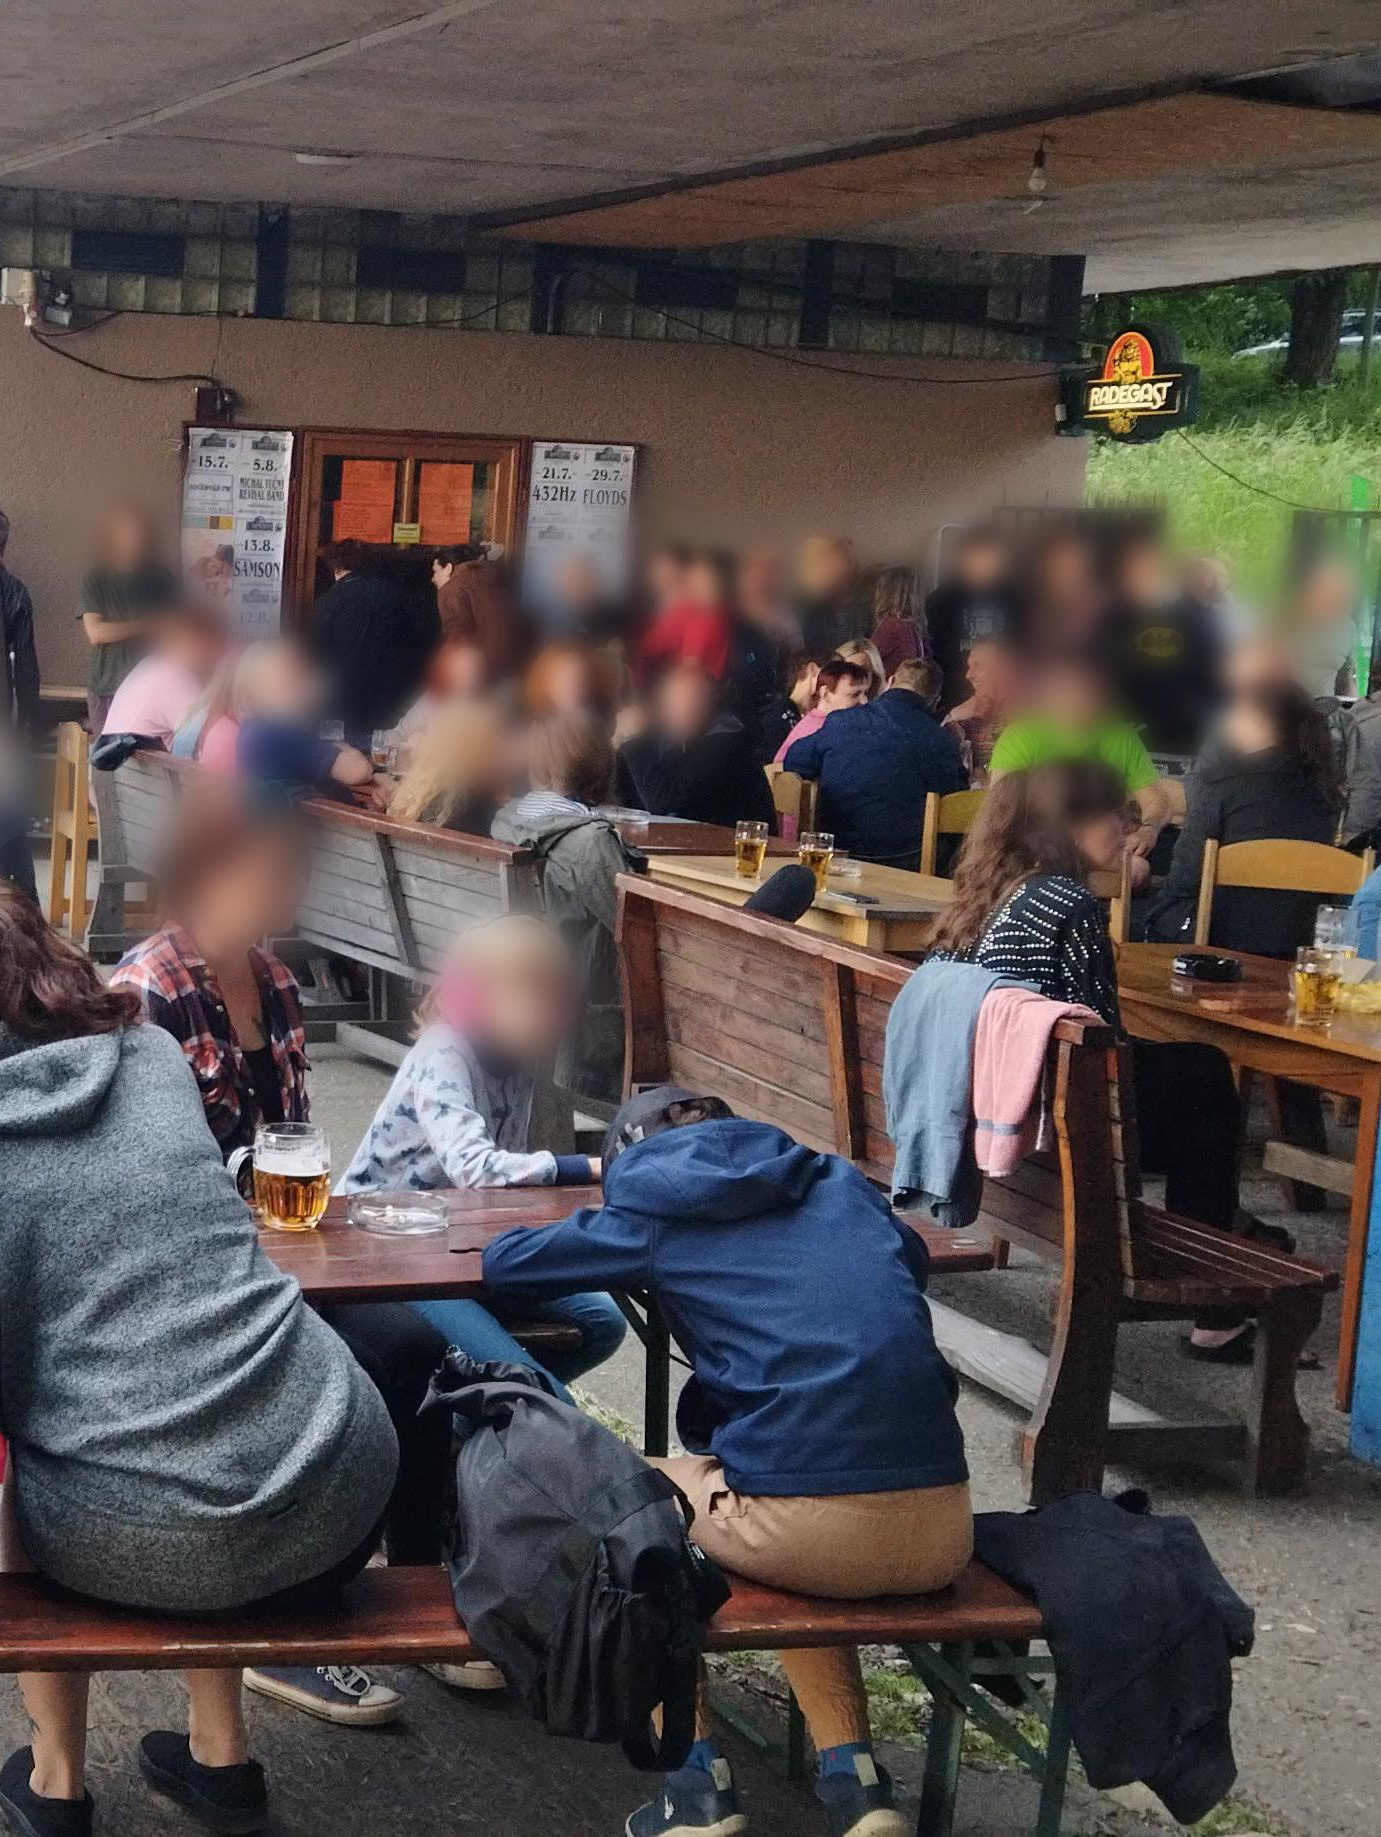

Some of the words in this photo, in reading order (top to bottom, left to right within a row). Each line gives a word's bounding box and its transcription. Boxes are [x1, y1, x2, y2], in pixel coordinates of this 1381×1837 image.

[1089, 382, 1173, 410] RADEGAST
[199, 456, 228, 469] 15.7.
[253, 459, 277, 472] 5.8.
[542, 467, 572, 480] 21.7.
[591, 469, 623, 481] 29.7.
[532, 484, 577, 502] 432Hz
[582, 489, 627, 506] FLOYDS
[244, 540, 275, 552] 13.8.
[234, 561, 281, 578] SAMSON
